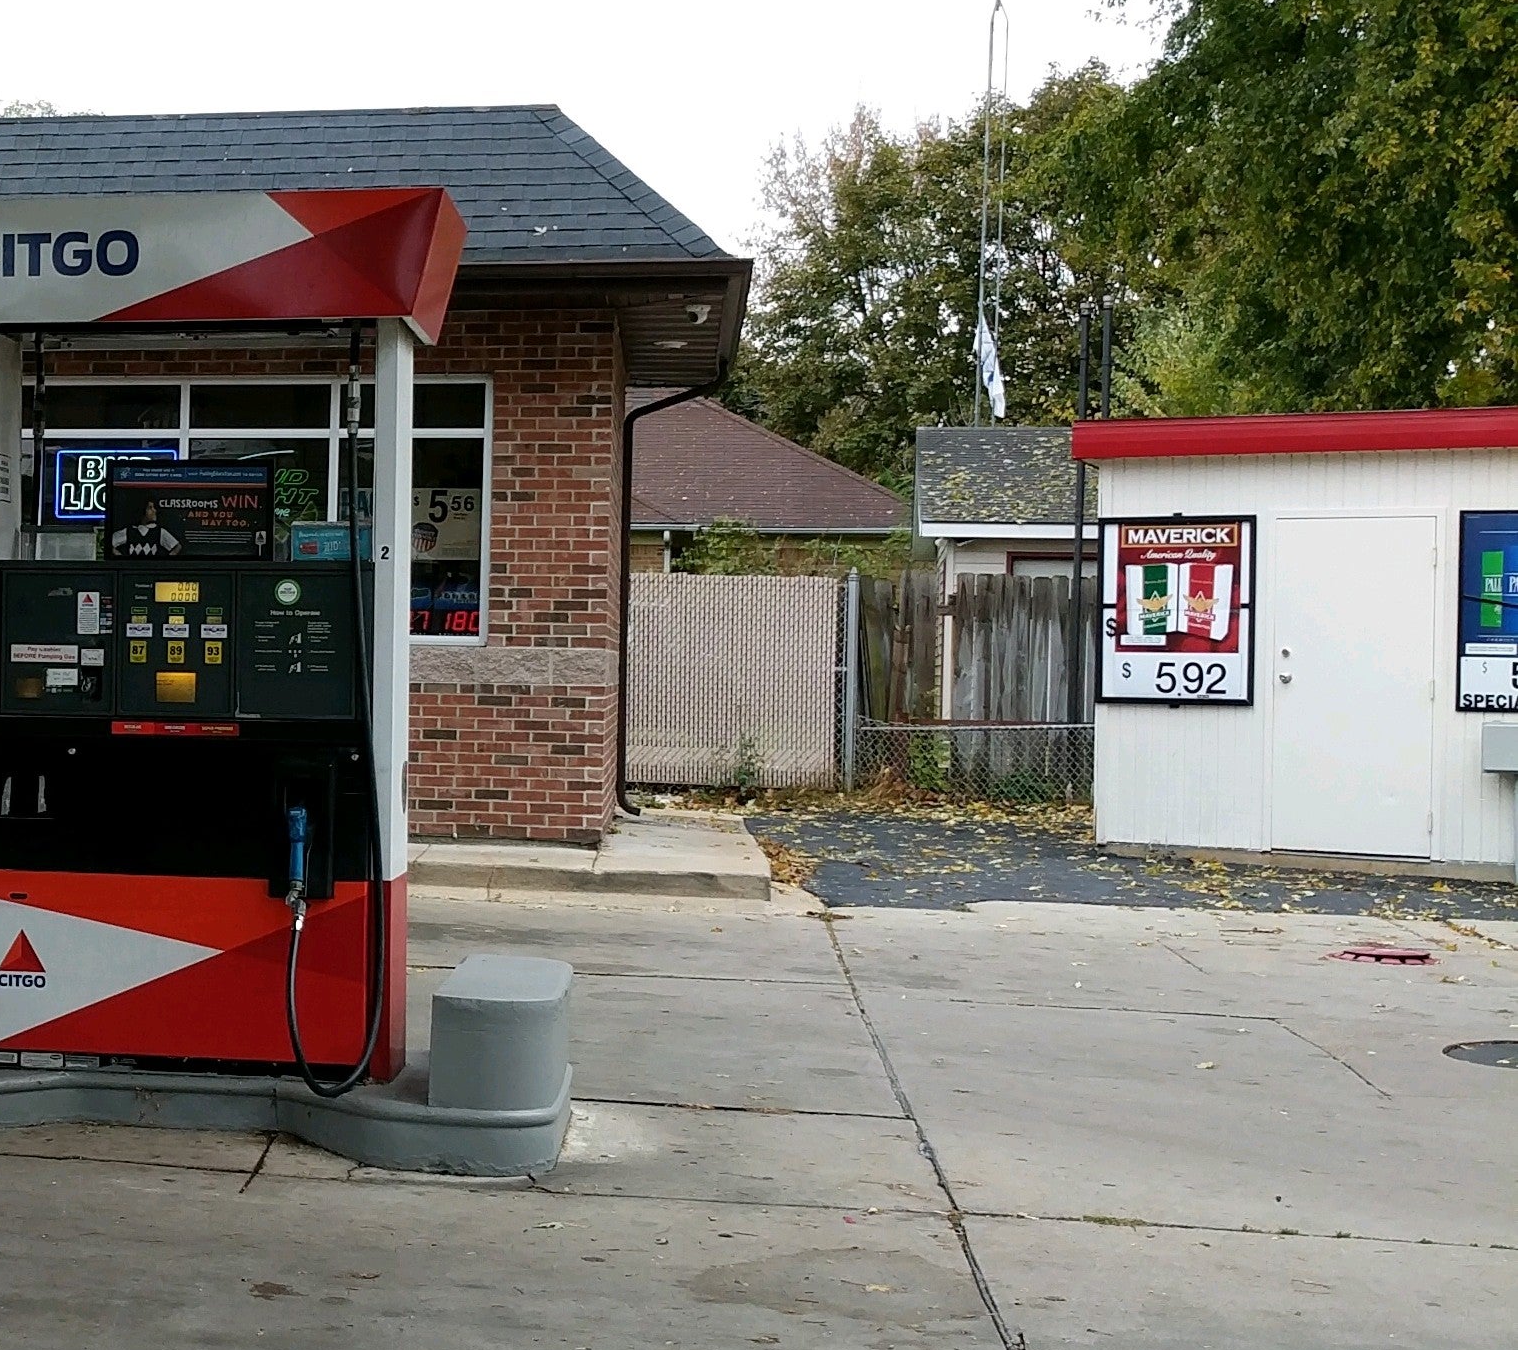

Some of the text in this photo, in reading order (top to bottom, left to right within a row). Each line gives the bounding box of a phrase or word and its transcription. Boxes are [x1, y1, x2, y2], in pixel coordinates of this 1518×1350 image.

[159, 499, 218, 509] CLASSROOMS
[414, 495, 420, 507] $
[1127, 528, 1231, 545] MAVERICK
[380, 546, 390, 560] 2
[1140, 548, 1217, 561] American Quality
[131, 645, 220, 656] 87 89 93
[1121, 661, 1227, 697] $ 5.92
